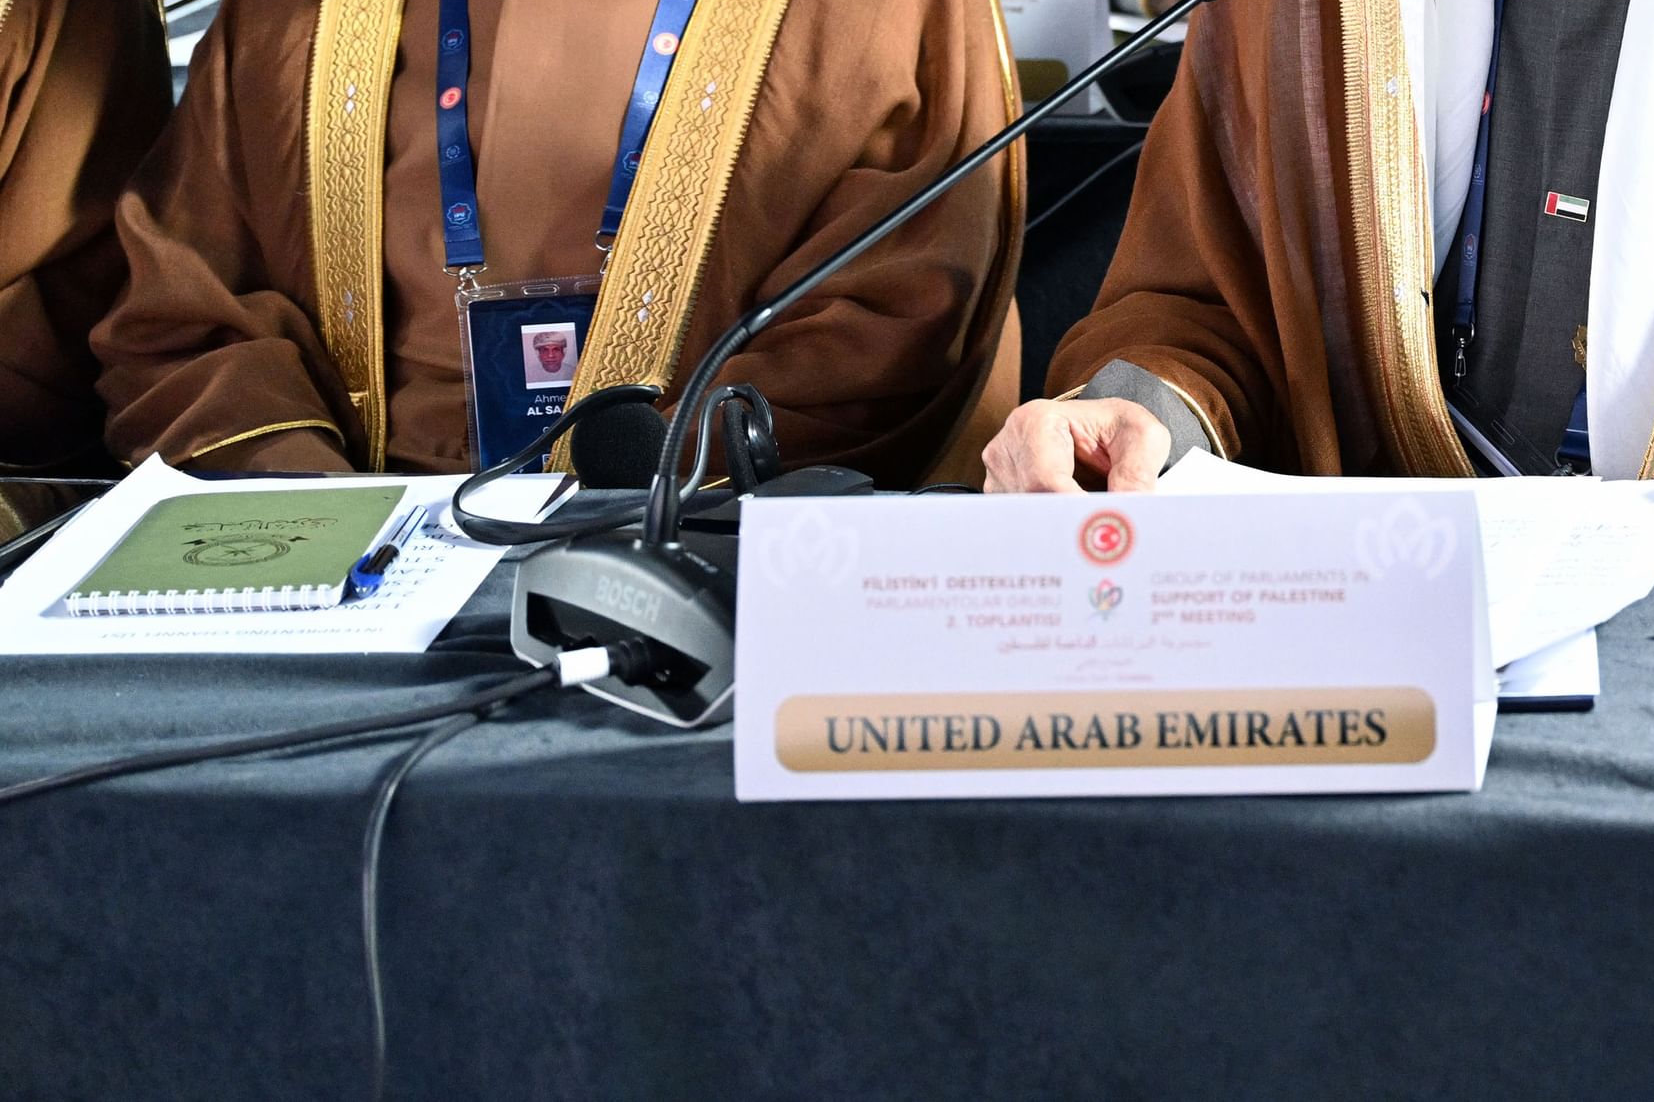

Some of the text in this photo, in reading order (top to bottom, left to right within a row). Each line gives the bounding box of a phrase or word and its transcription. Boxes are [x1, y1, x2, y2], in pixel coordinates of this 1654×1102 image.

[535, 394, 567, 404] Ahme
[527, 405, 562, 416] AL SA
[945, 575, 1063, 589] DESTEKLEYEN
[1150, 570, 1208, 585] GROUP
[1212, 570, 1233, 584] OF
[595, 576, 662, 623] BOSCH
[1150, 588, 1346, 605] SUPPORT OF PALESTINE
[1180, 609, 1256, 624] MEETING
[825, 708, 1388, 754] UNITED ARAB EMIRATES
